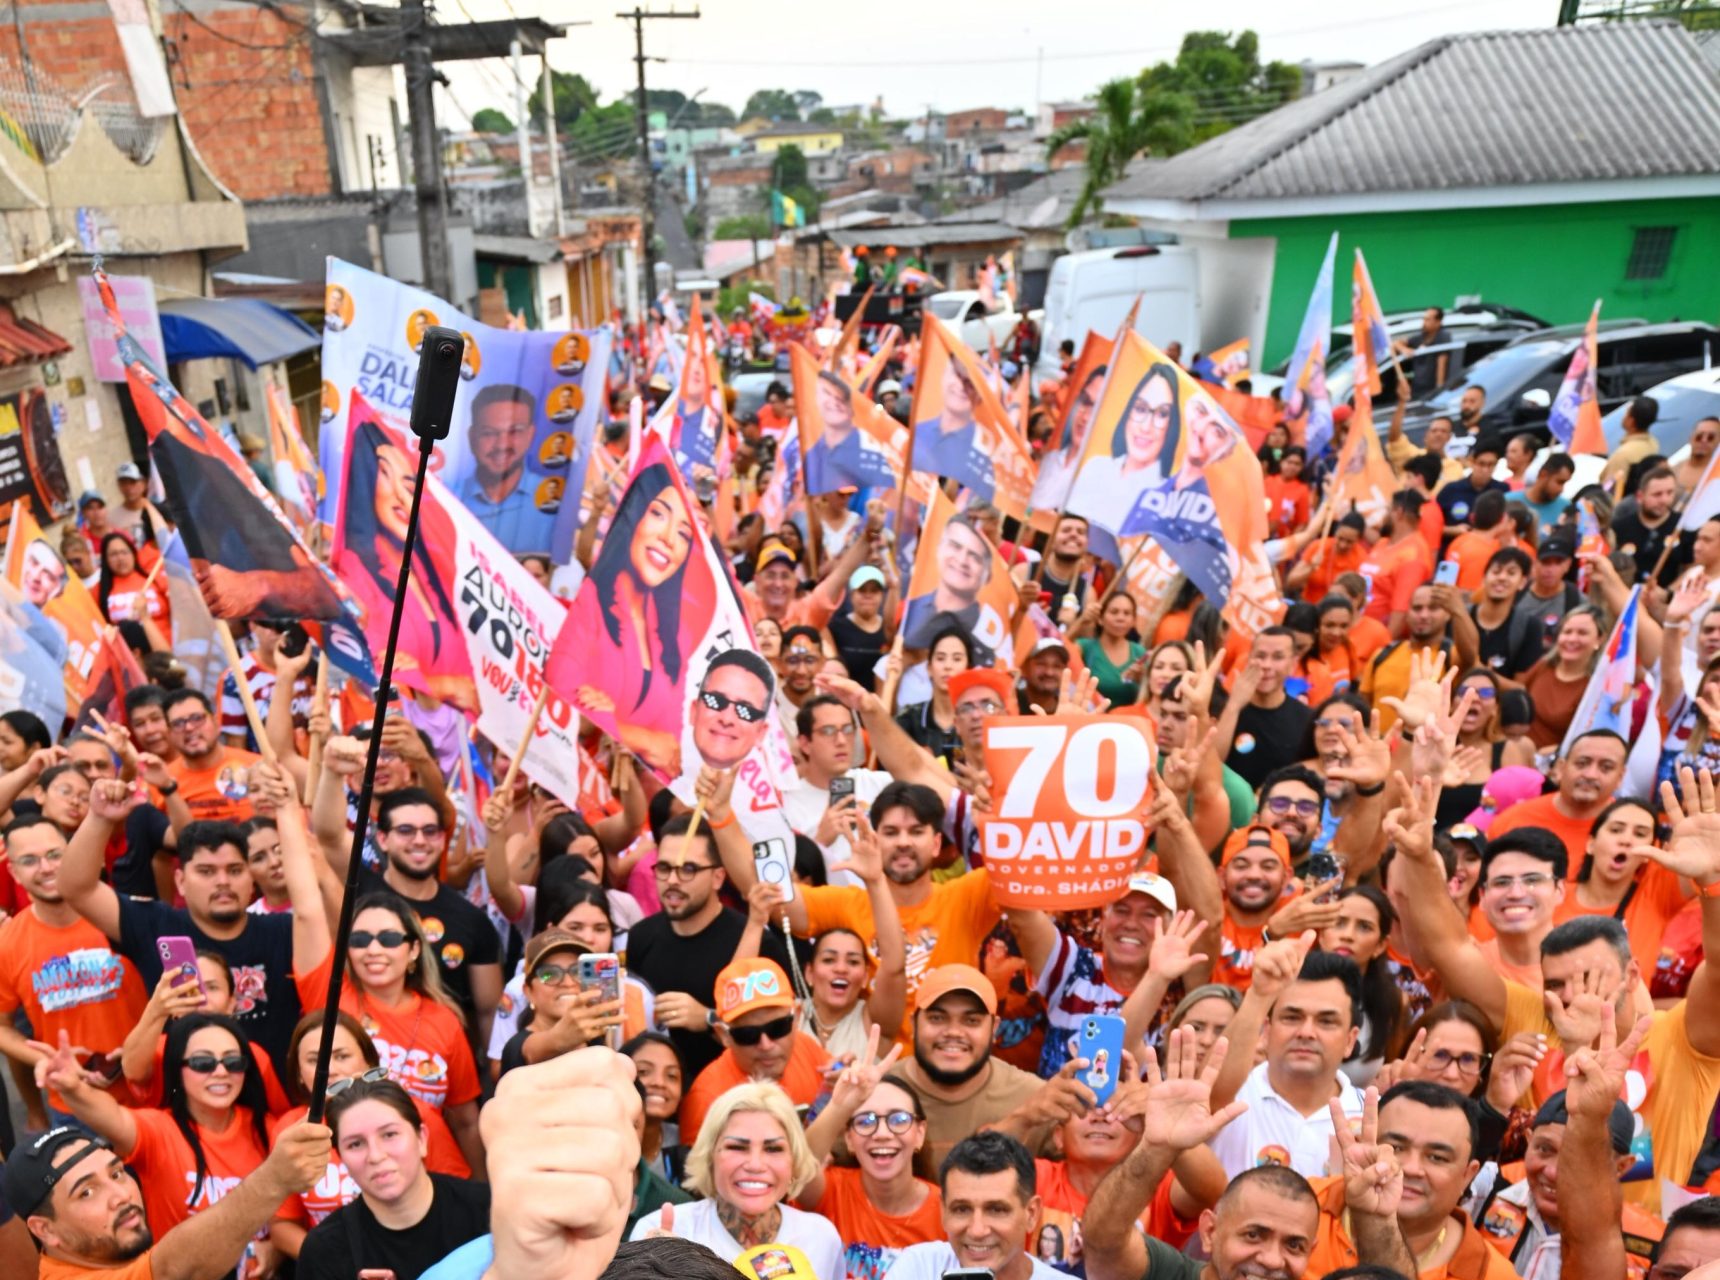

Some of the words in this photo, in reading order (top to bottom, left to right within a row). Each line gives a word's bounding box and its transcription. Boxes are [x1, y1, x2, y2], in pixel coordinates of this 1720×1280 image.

[360, 351, 418, 391] DAL
[987, 722, 1151, 819] 70
[984, 818, 1145, 861] DAVID
[1008, 881, 1052, 895] Dra.
